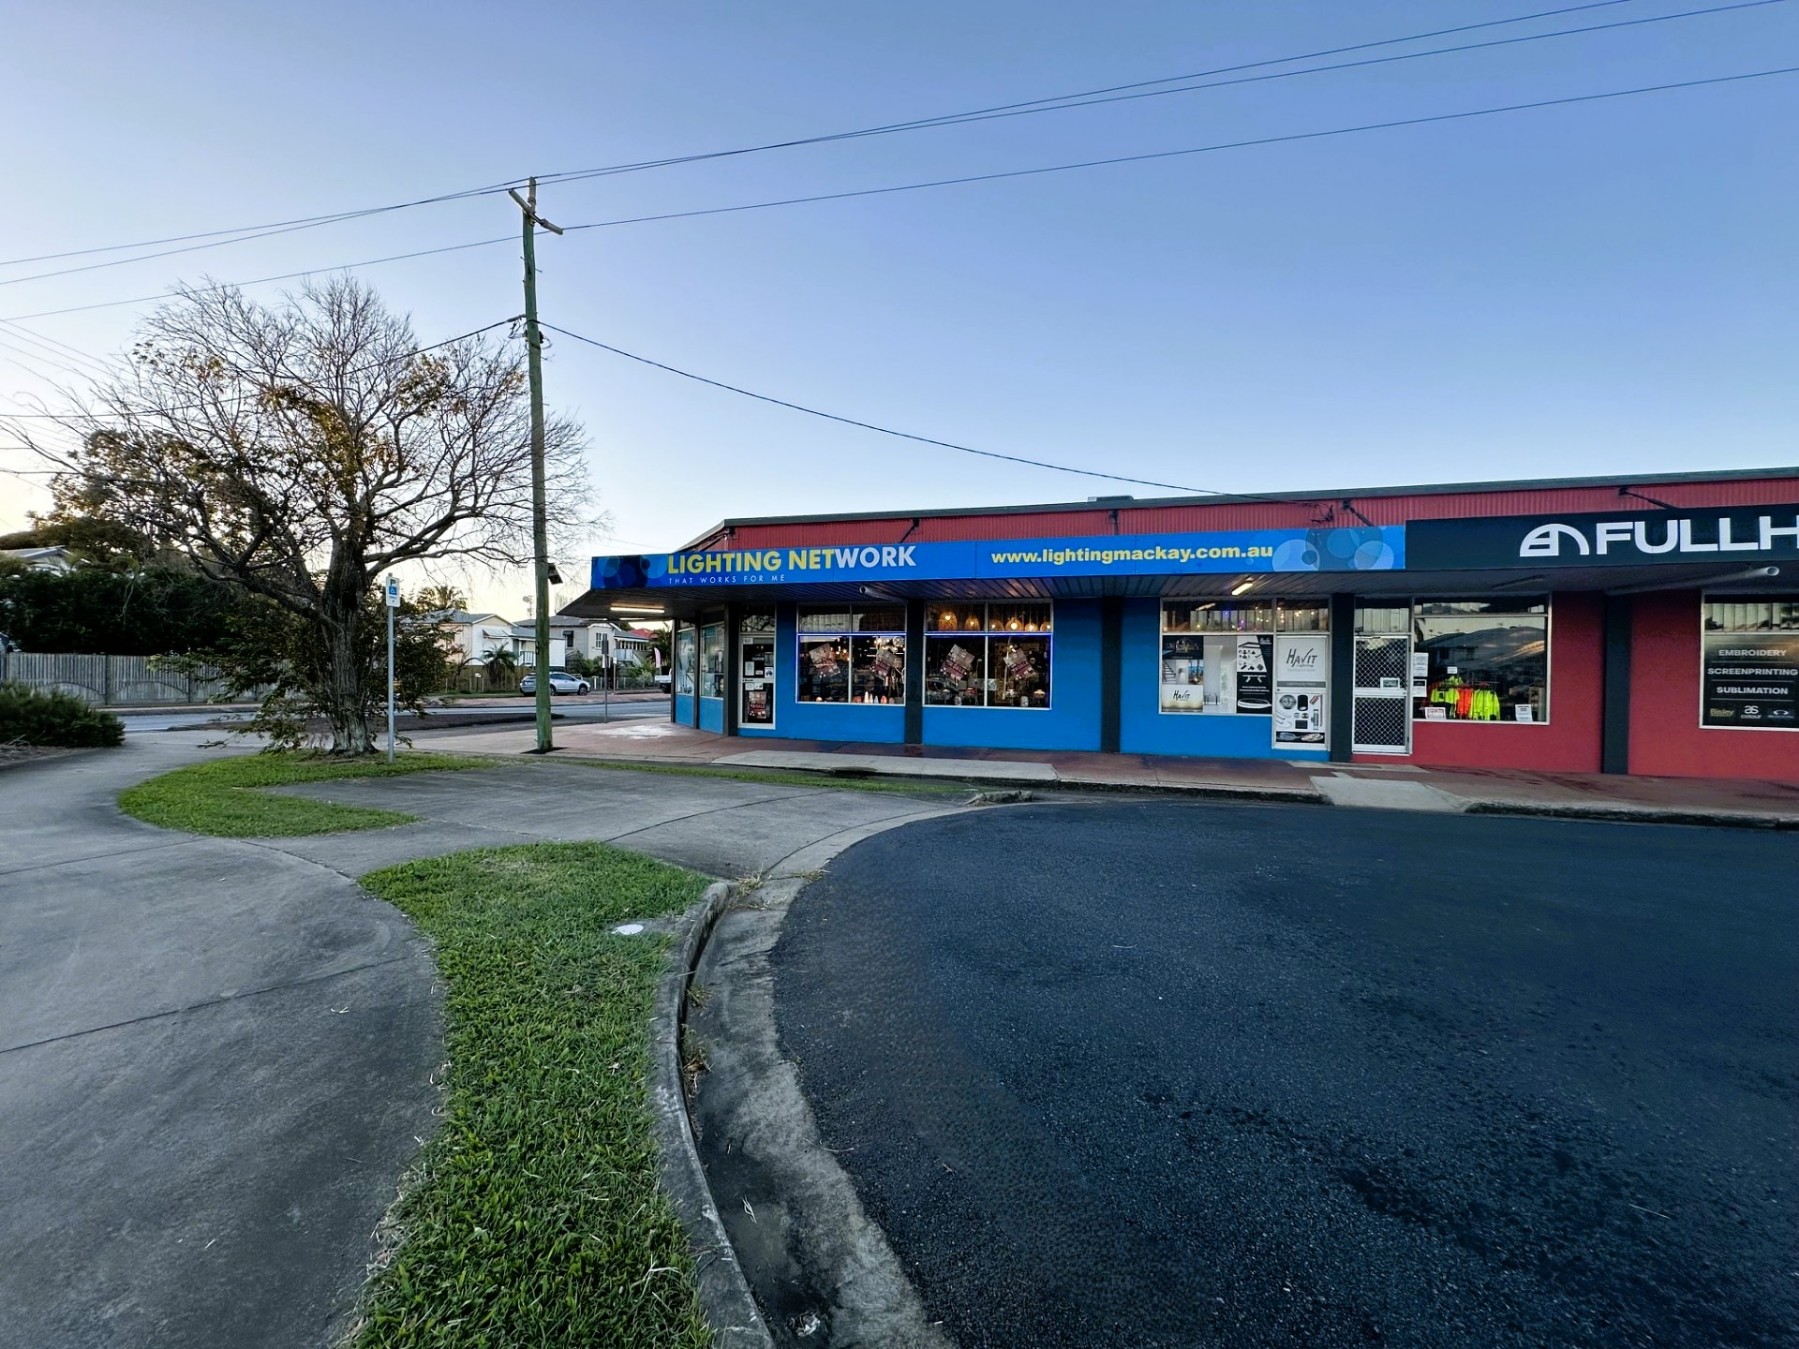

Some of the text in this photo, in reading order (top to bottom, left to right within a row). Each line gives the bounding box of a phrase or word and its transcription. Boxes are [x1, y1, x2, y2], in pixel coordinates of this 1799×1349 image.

[668, 545, 917, 573] LIGHTING NETWORK
[991, 546, 1273, 564] www.lightingmackay.com.au
[669, 577, 693, 585] THAT
[700, 575, 737, 583] WORKS
[1718, 649, 1787, 657] EMBROIDERY
[1707, 667, 1798, 676] SCREENPRINTING
[1716, 686, 1789, 695] SUBLIMATION
